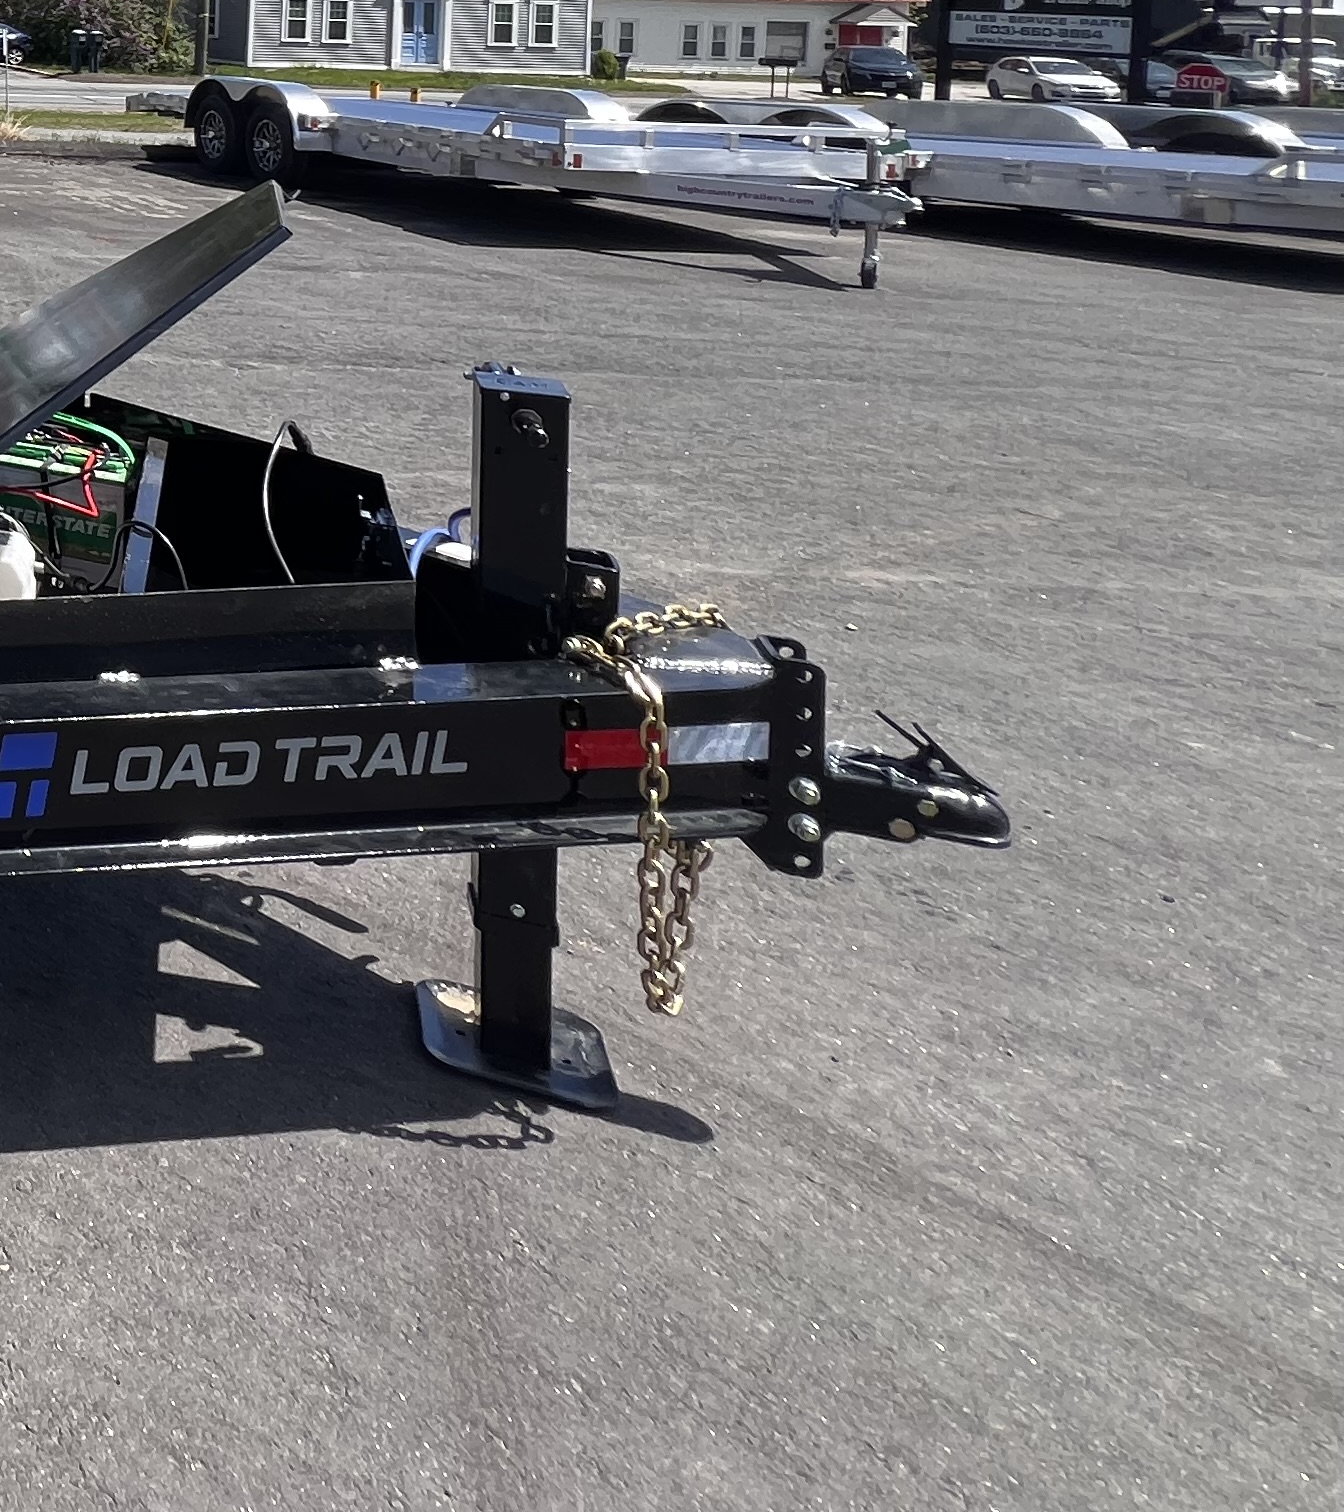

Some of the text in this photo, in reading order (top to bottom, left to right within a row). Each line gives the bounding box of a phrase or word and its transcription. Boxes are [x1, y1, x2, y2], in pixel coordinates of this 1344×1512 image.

[1008, 15, 1067, 26] SERVICE
[1080, 18, 1130, 28] PARTS
[1180, 74, 1226, 89] STOP
[677, 185, 814, 205] highcountrytrailers.com
[6, 506, 112, 538] TERSTATE
[69, 730, 468, 795] LOAD TRAIL
